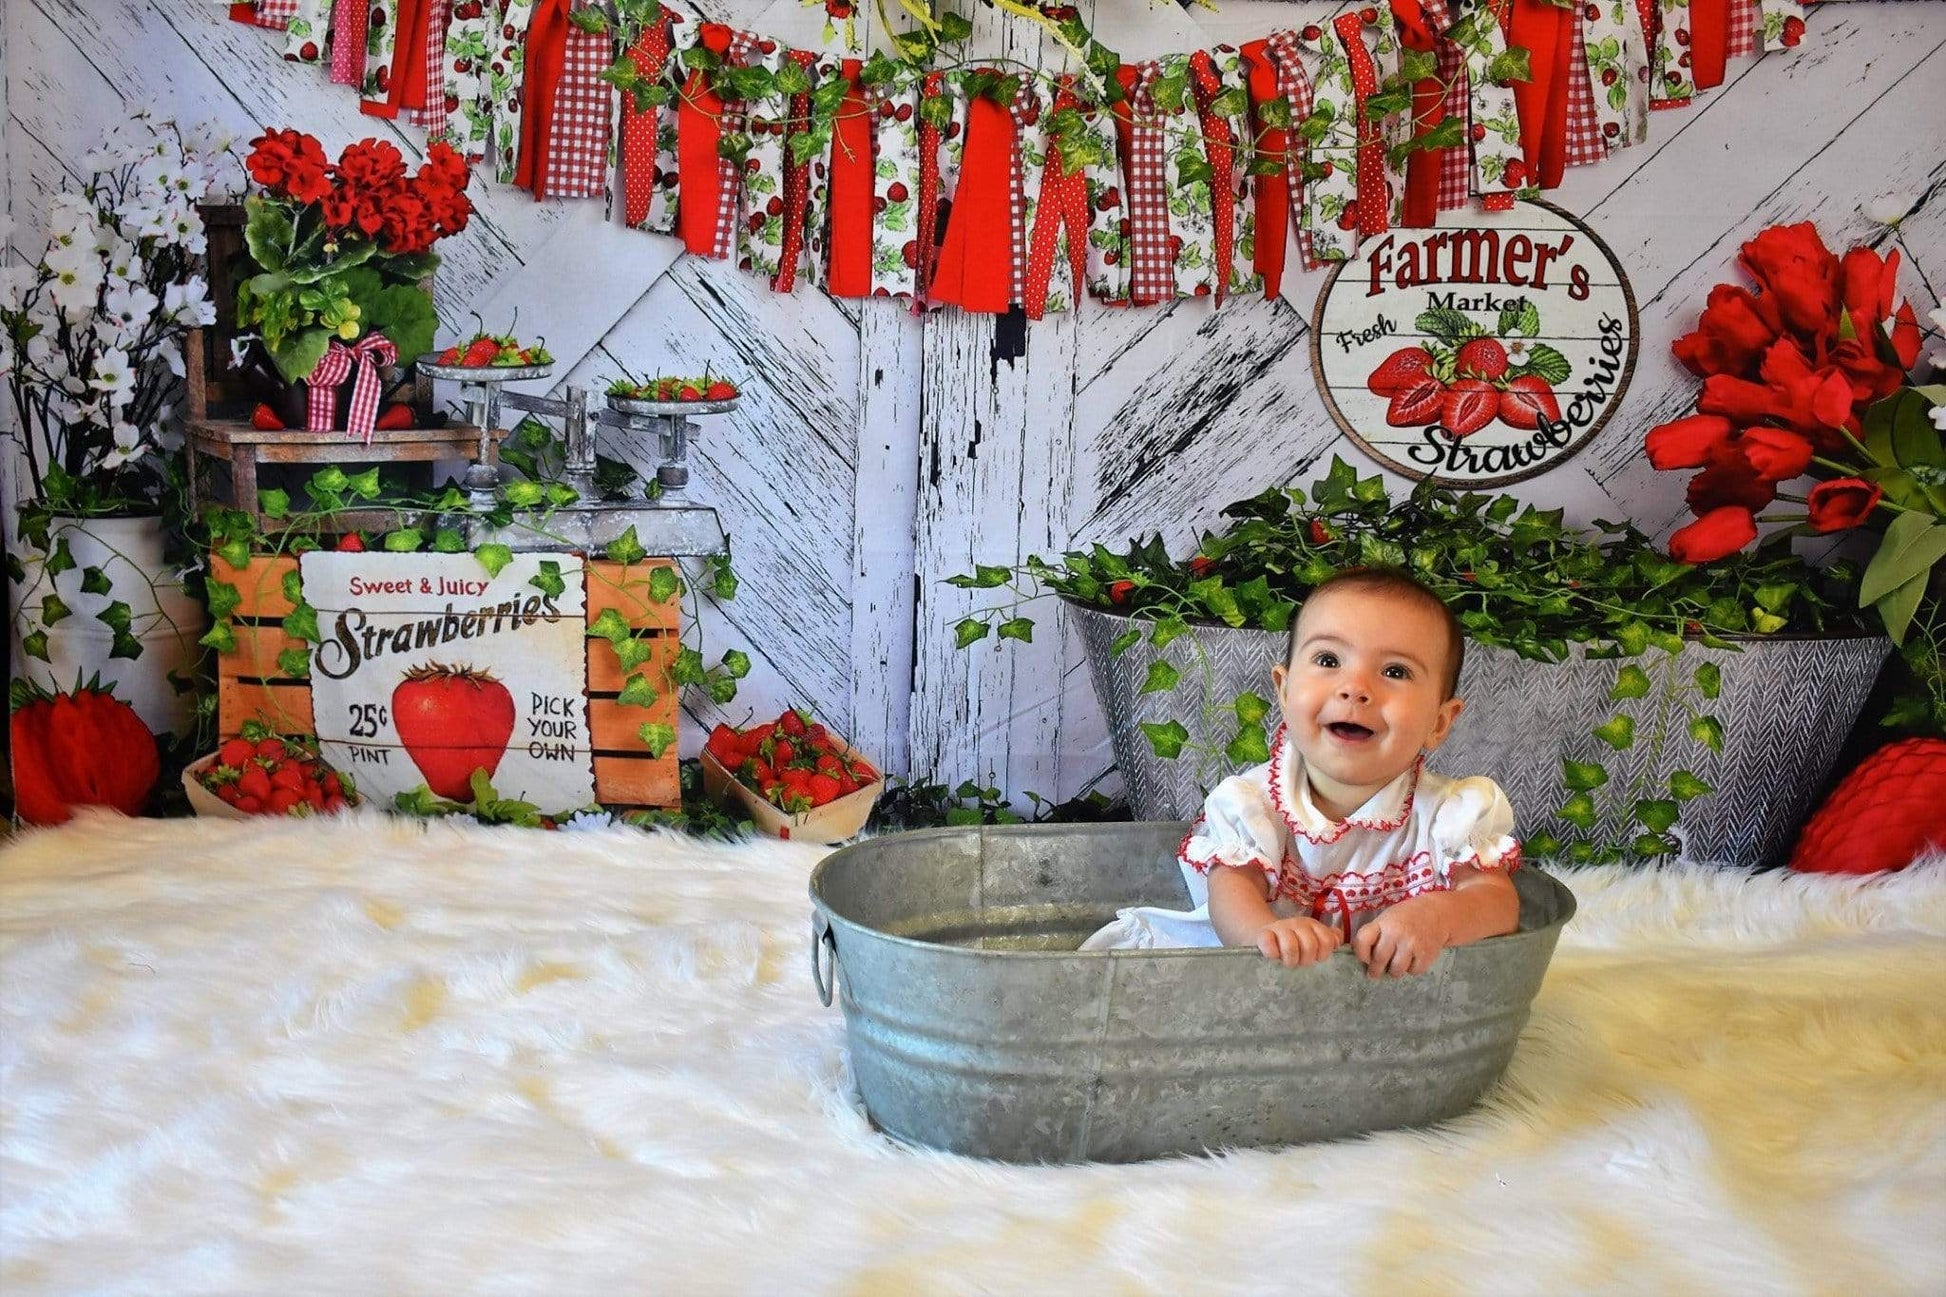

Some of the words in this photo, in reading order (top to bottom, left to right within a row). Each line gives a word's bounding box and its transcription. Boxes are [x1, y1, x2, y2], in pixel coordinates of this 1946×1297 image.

[1365, 228, 1590, 301] Farmer's
[1426, 291, 1528, 313] Market
[1335, 313, 1398, 354] Fresh
[1407, 311, 1623, 474] Strawberries
[349, 576, 413, 596] Sweet
[419, 577, 433, 594] &
[436, 576, 490, 597] Juicy
[314, 592, 561, 680] Strawberries
[531, 691, 576, 718] PICK
[349, 703, 388, 738] 25¢
[527, 717, 577, 740] YOUR
[348, 746, 391, 766] PINT
[528, 741, 576, 763] OWN
